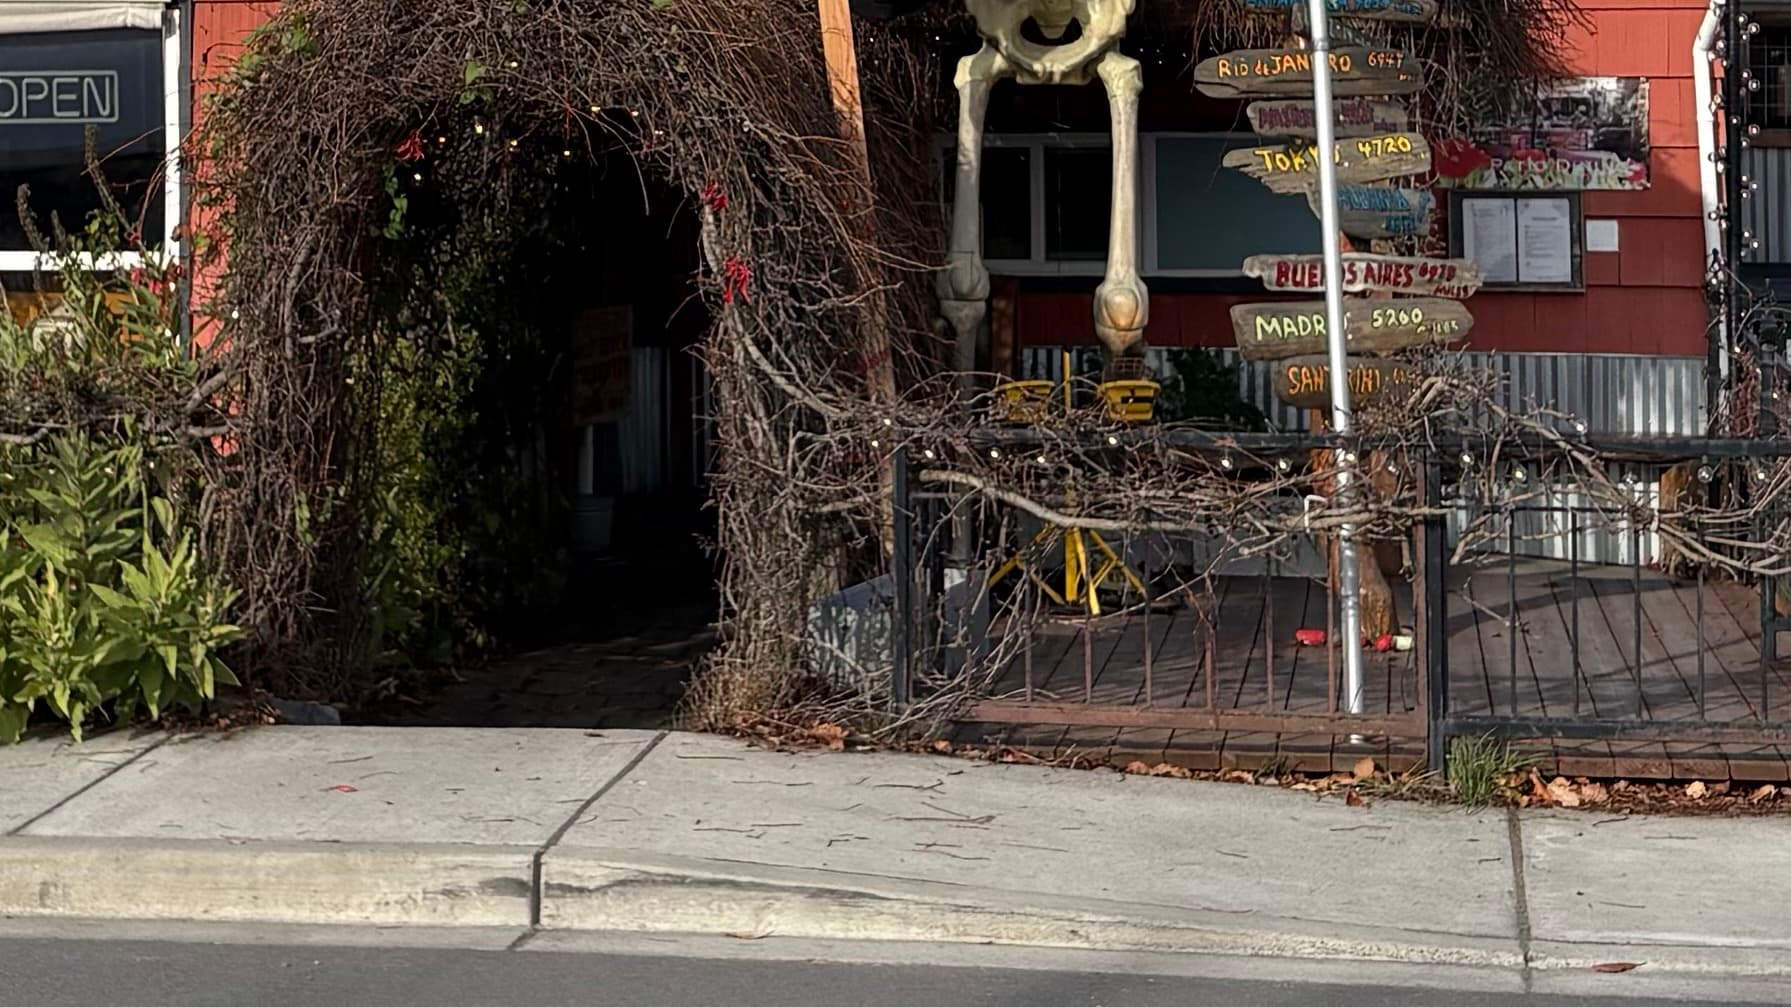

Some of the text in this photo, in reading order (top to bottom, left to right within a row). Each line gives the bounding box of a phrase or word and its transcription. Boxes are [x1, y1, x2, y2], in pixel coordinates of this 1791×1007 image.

[1270, 54, 1352, 75] JANRO
[1253, 145, 1341, 172] TOKY
[1358, 136, 1412, 158] 4720
[1275, 261, 1358, 289] BUES
[1362, 262, 1415, 289] AIRES
[1255, 312, 1352, 342] MADR
[1371, 307, 1424, 329] 5260
